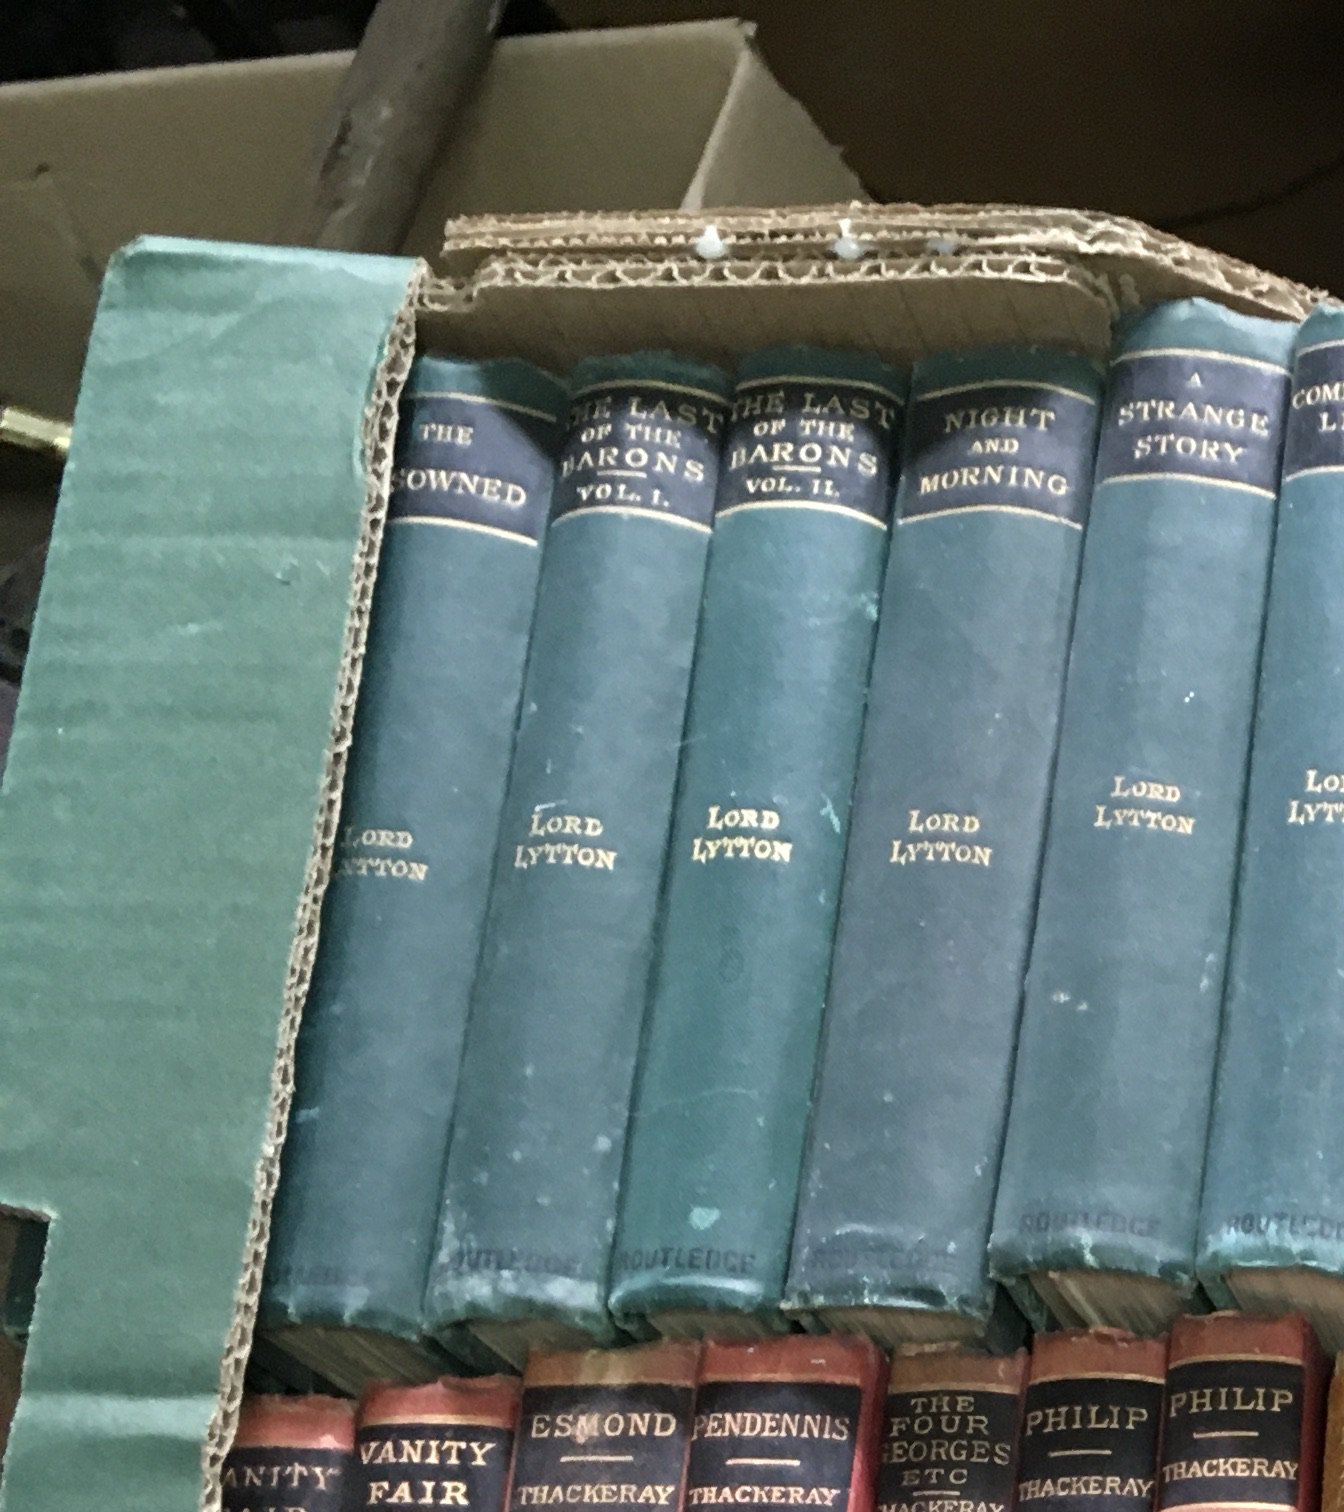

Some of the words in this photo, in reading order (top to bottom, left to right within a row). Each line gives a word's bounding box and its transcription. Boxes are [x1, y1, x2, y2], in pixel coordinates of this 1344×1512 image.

[1184, 371, 1205, 389] A
[627, 395, 726, 434] LAST
[731, 390, 787, 422] THE
[802, 391, 896, 430] LAST
[943, 406, 1057, 434] NIGHT
[1117, 399, 1271, 437] STRANGE
[420, 422, 474, 447] THE
[580, 422, 613, 443] OF
[624, 421, 683, 449] THE
[753, 418, 787, 438] OF
[800, 419, 856, 442] THE
[729, 441, 879, 477] BARONS
[967, 437, 1020, 457] AND
[1132, 432, 1247, 464] STORY
[560, 445, 706, 483] BARONS
[401, 466, 528, 508] OWNED
[576, 482, 642, 502] VOL.
[745, 476, 802, 495] VOL.
[918, 464, 1072, 497] MORNING
[1110, 775, 1182, 803] LORD
[527, 812, 605, 838] LORD
[707, 805, 780, 831] LORD
[908, 808, 981, 834] LORD
[1093, 804, 1196, 835] LYTTON
[514, 842, 619, 872] LYTTON
[691, 835, 793, 865] LYTTON
[889, 839, 993, 867] LYTTON
[618, 1245, 756, 1276] ROUTLEDGE
[911, 1395, 976, 1413] THE
[1169, 1387, 1294, 1418] PHILIP
[531, 1412, 677, 1440] ESMOND
[691, 1411, 851, 1441] PENDENNIS
[889, 1415, 990, 1437] FOUR
[1025, 1405, 1149, 1437] PHILIP
[360, 1439, 497, 1467] VANITY
[880, 1440, 1012, 1466] GEORGES
[221, 1462, 342, 1491] ANITY
[902, 1468, 968, 1487] ETC
[1163, 1457, 1298, 1482] THACKERAY
[367, 1480, 471, 1507] FAIR
[517, 1483, 676, 1506] THACKERAY
[688, 1485, 841, 1508] THACKERAY
[1018, 1475, 1156, 1503] THACKERAY
